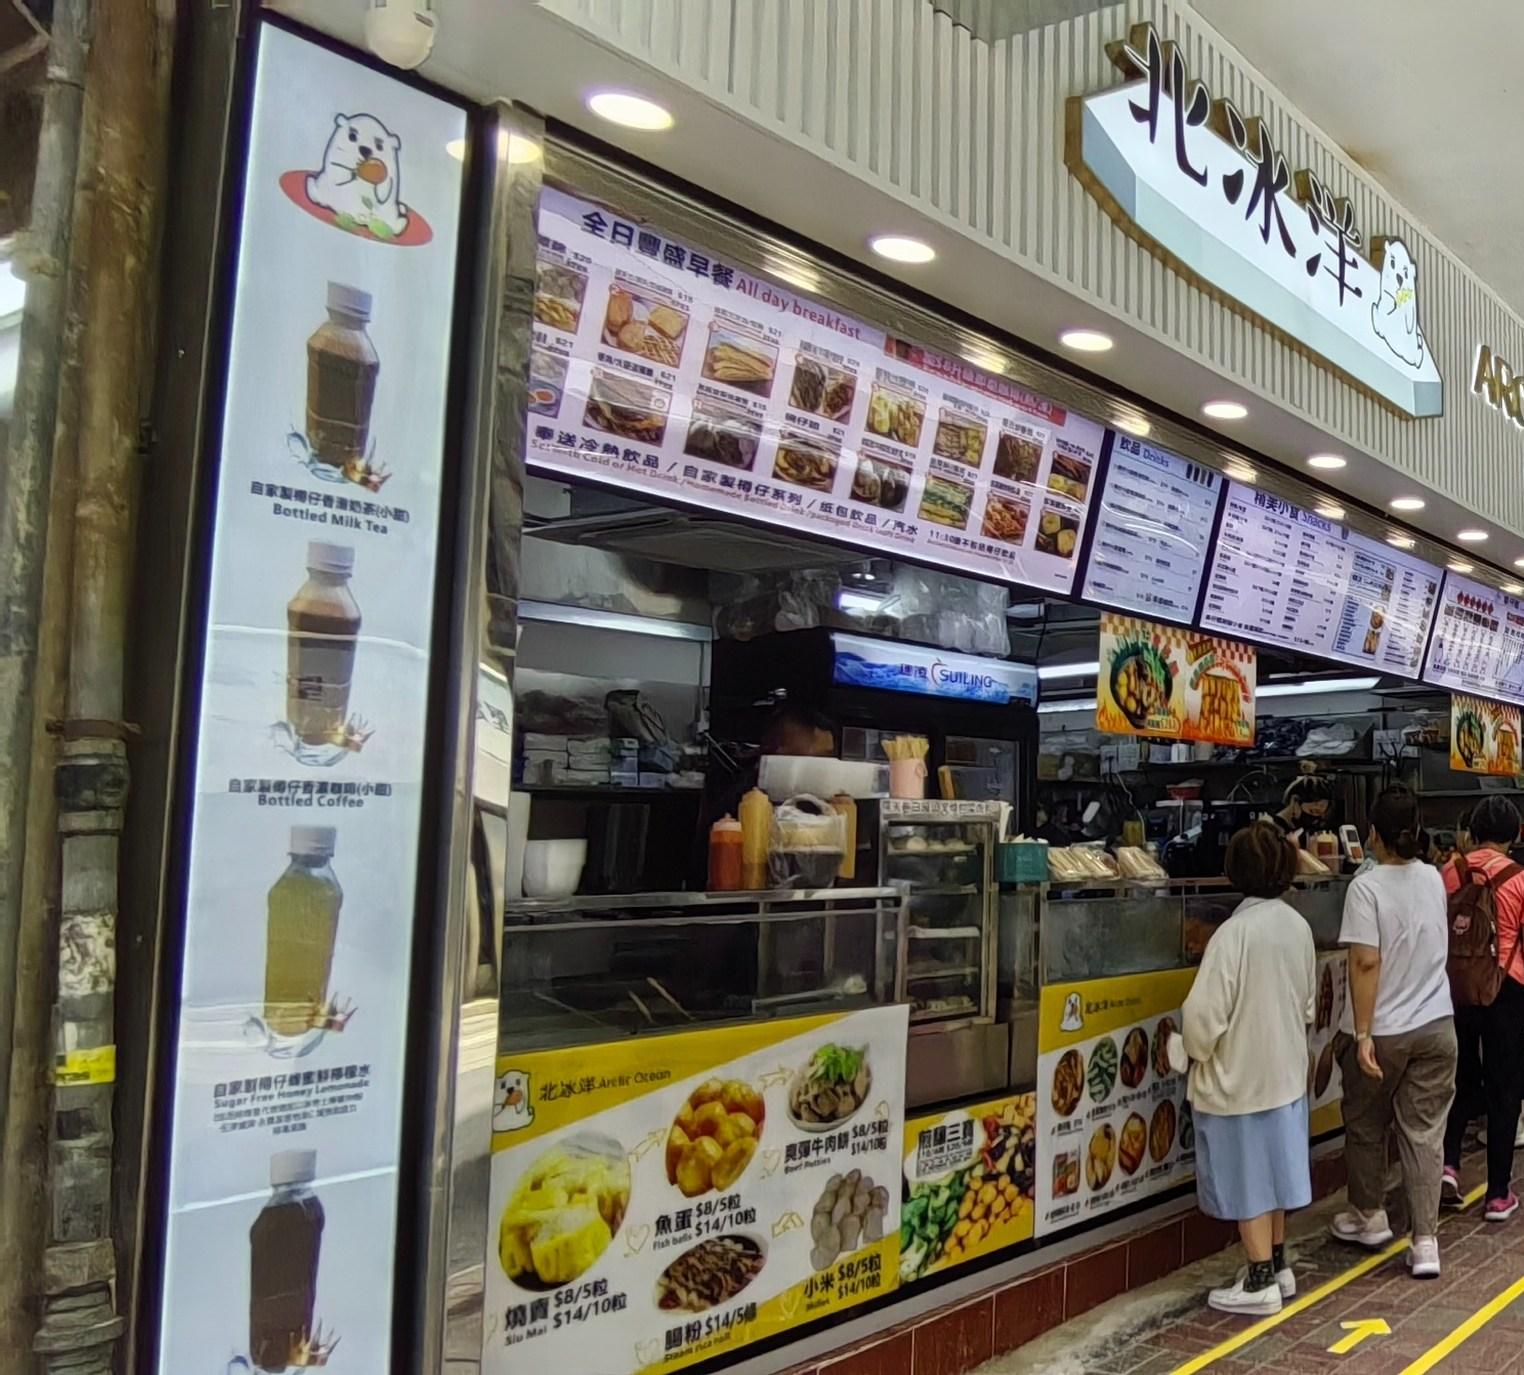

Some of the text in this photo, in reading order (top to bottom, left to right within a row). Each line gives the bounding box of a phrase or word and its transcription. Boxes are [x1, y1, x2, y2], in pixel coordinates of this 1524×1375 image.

[1123, 25, 1363, 307] 北冰洋
[581, 211, 735, 291] 全日豐盛早餐
[736, 278, 759, 300] All
[762, 289, 790, 313] day
[793, 299, 861, 341] breakfast
[582, 453, 610, 466] Cold
[1120, 436, 1141, 456] 飲品
[273, 503, 388, 534] Bottled Milk Tea
[940, 669, 993, 688] SUILING
[258, 794, 365, 808] Bottled Coffee
[214, 1094, 249, 1109] Sugar
[251, 1094, 275, 1105] Free
[277, 1088, 314, 1100] Honey
[315, 1079, 370, 1094] Lemonade
[539, 1070, 671, 1102] 北冰洋 Arctic Ocean
[695, 1193, 741, 1218] $8/5粒
[655, 1208, 693, 1237] 魚蛋
[695, 1206, 757, 1237] $14/10粒
[653, 1233, 692, 1250] Fish balls
[838, 1253, 881, 1282] $8/5粒
[553, 1278, 609, 1308] $8/5粒
[804, 1271, 834, 1299] 小米
[504, 1297, 550, 1331] 燒賣
[552, 1292, 628, 1329] $14/10粒
[504, 1326, 548, 1347] Siu Mai
[665, 1320, 703, 1351] 腸粉
